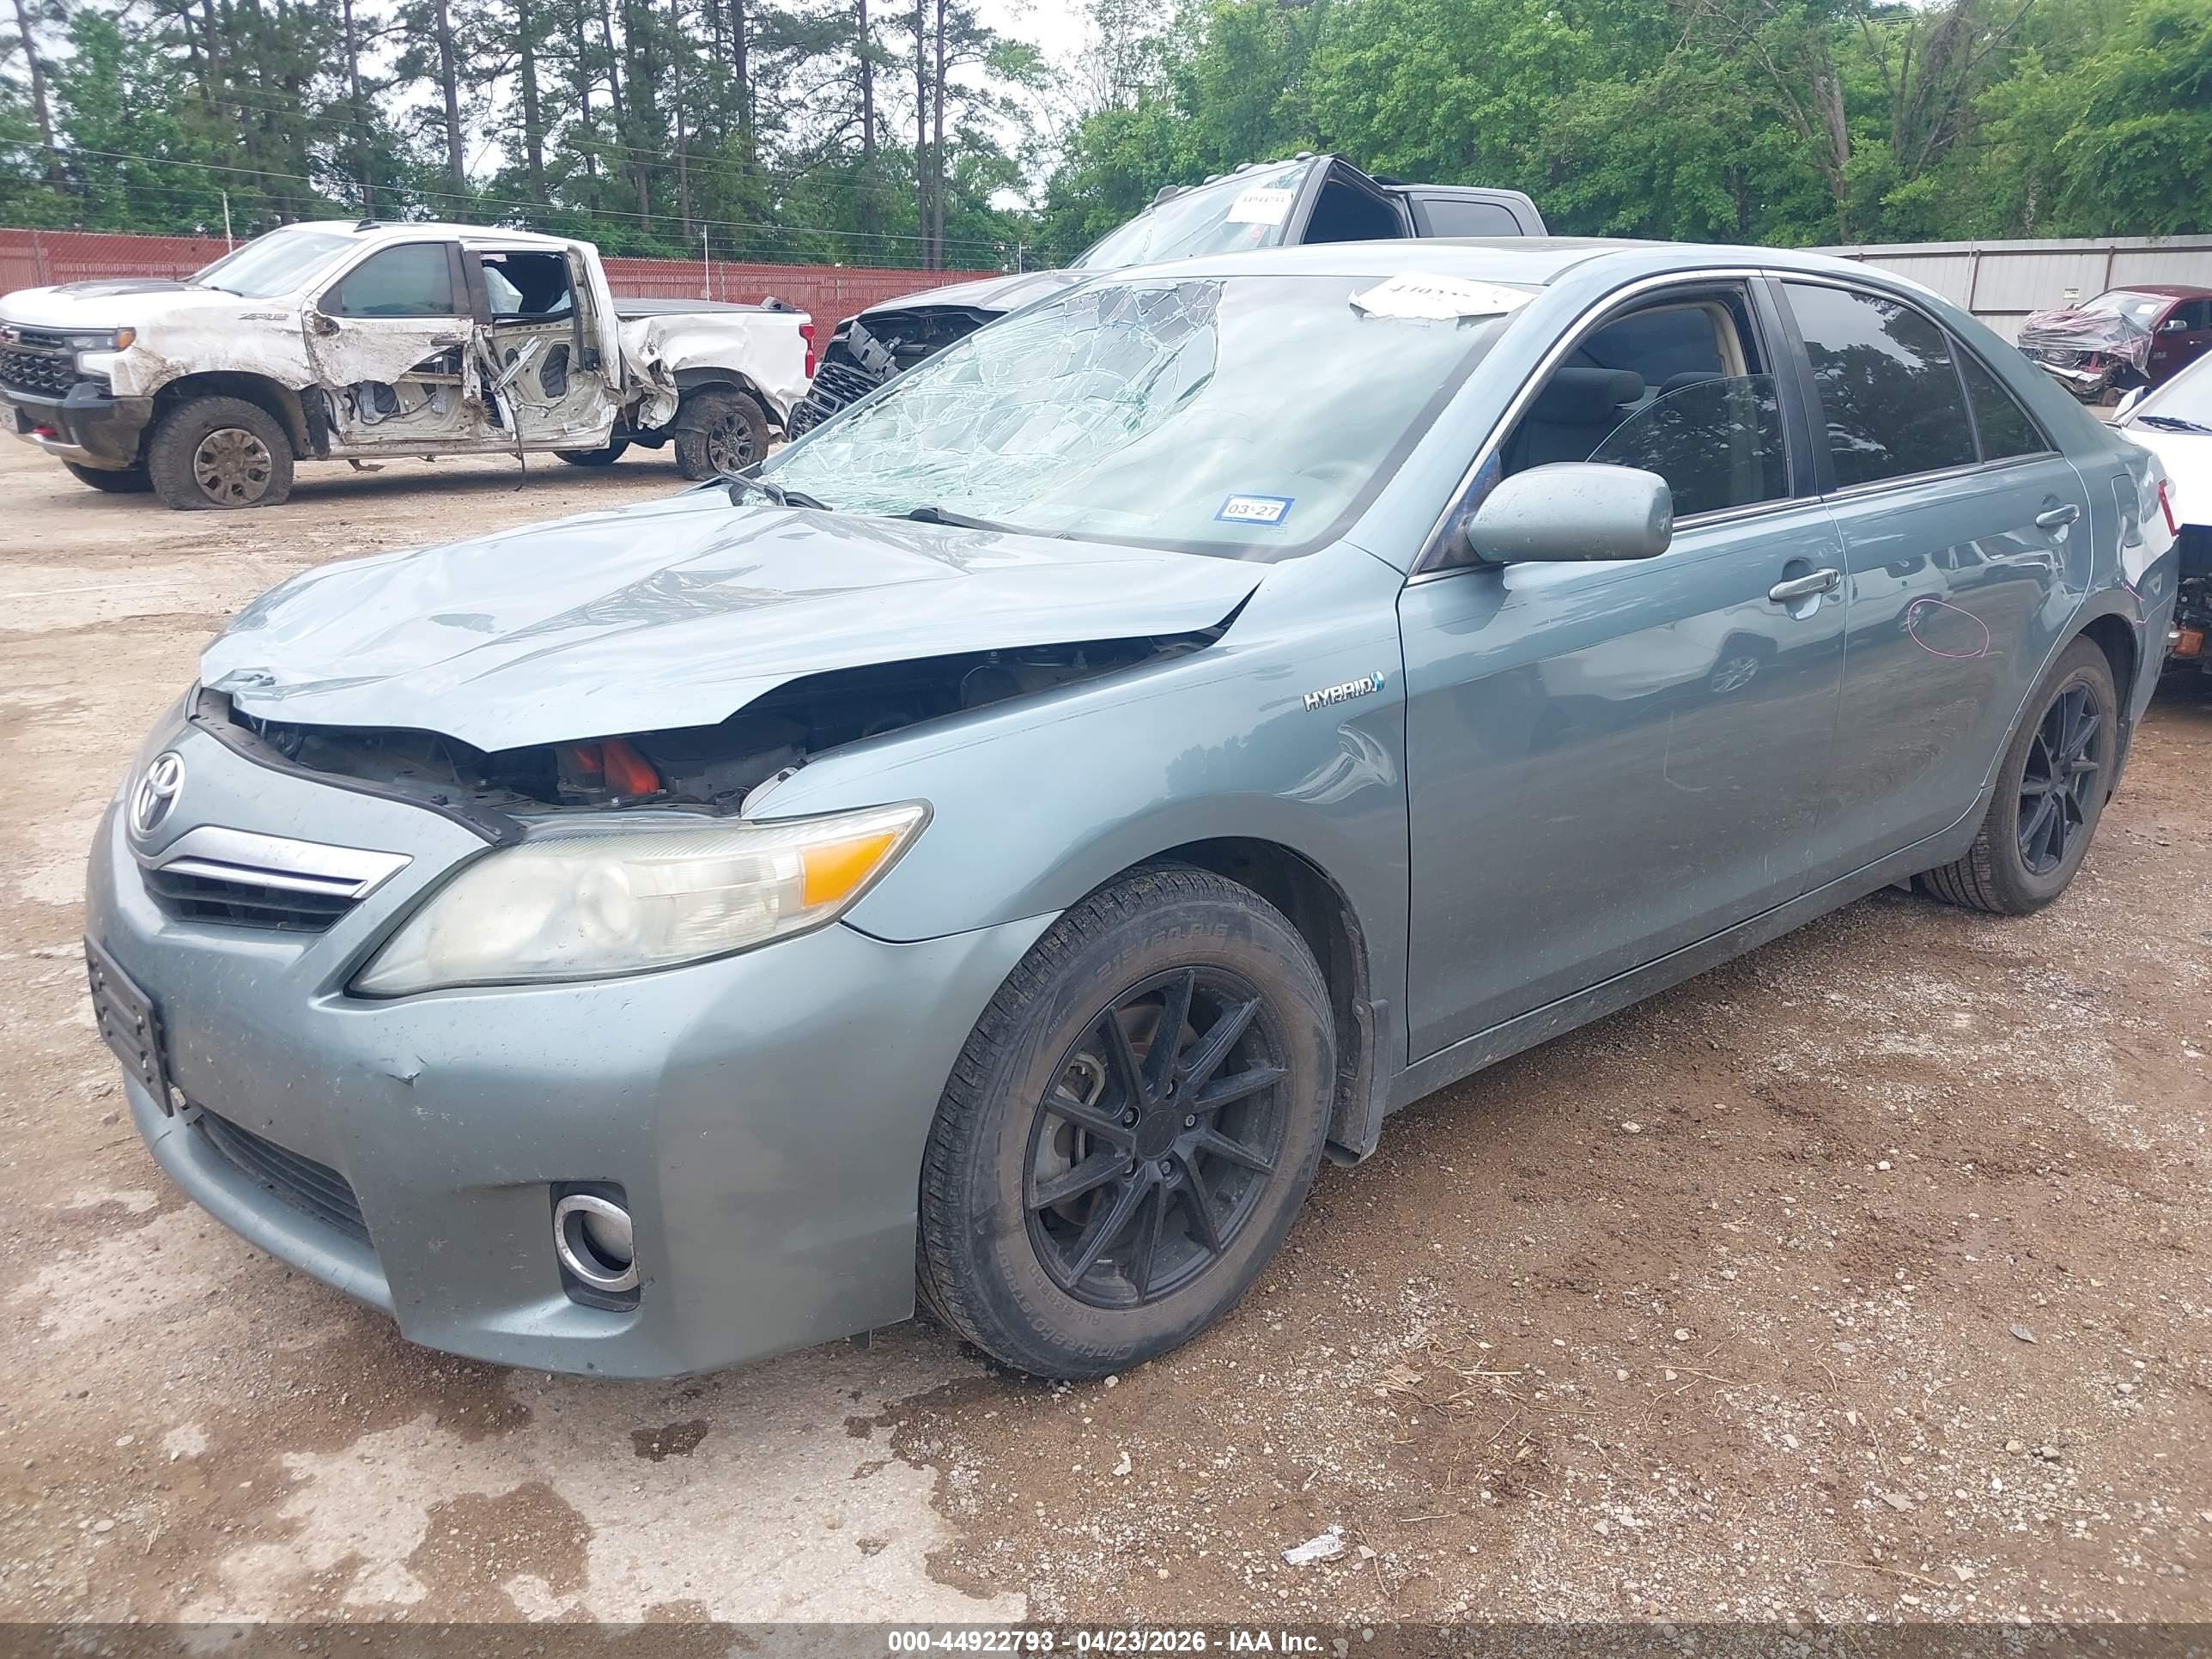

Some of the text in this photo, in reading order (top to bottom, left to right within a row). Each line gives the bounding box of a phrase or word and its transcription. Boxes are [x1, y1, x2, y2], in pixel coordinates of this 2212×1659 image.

[237, 313, 289, 321] ZR2
[1228, 503, 1249, 514] 03
[1255, 505, 1279, 516] 27
[1302, 677, 1374, 712] HYBRID
[996, 1242, 1031, 1313] STRADA
[1078, 1310, 1101, 1326] ALL
